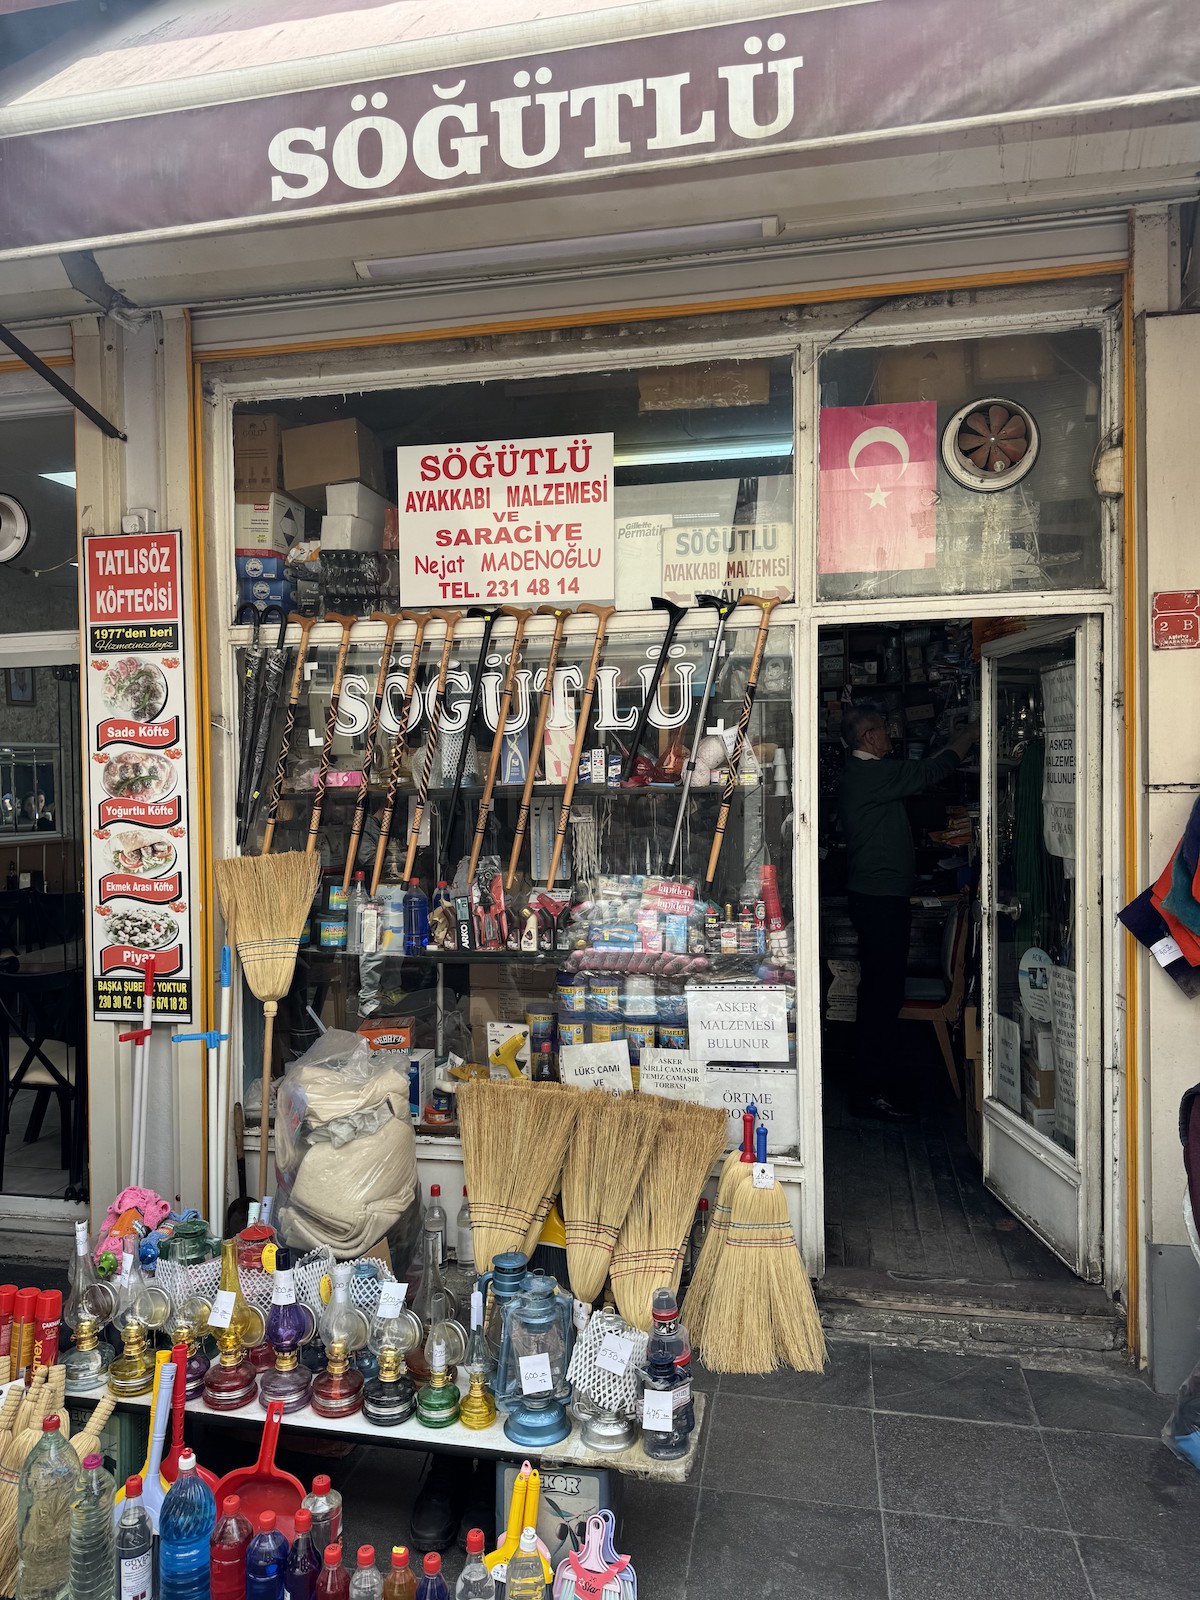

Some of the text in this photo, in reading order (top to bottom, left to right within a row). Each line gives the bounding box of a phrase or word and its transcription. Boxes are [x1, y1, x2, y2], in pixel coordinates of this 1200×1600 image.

[268, 33, 803, 201] SÖĞÜTLÜ
[420, 439, 592, 482] SÖĞÜTLÜ
[405, 475, 608, 513] AYAKKABI MALZEMESİ
[492, 511, 519, 523] VE
[626, 522, 652, 530] Gillette
[435, 522, 582, 547] SARACİYE
[676, 525, 777, 556] SÖĞÜTLÜ
[96, 542, 171, 576] TATLISÖZ
[415, 543, 601, 580] Nejat MADENOĞLU
[664, 556, 790, 582] AYAKKABI MALZEMESİ
[438, 576, 580, 599] TEL. 231 48 14
[96, 581, 173, 614] KÖFTECİSİ
[1159, 620, 1193, 631] 2 B
[94, 627, 173, 640] 1977'den beri
[107, 726, 170, 738] Sade Köfte
[1049, 739, 1073, 751] ASKER
[106, 805, 173, 818] Yoğurtlu Köfte
[106, 881, 174, 892] Ekmek Arası Köfte
[459, 923, 470, 949] ARKO
[97, 981, 122, 994] BAŞKA
[157, 982, 187, 993] YOKTUR
[99, 995, 112, 1008] 230
[112, 996, 122, 1009] 30
[123, 996, 132, 1009] 42
[156, 997, 168, 1010] 674
[169, 998, 178, 1010] 18
[179, 998, 188, 1010] 26
[715, 1002, 758, 1012] ASKER
[700, 1018, 775, 1031] MALZEMESİ
[707, 1038, 770, 1048] BULUNUR
[574, 1064, 620, 1076] LÜKS CAMI
[643, 1064, 698, 1074] KİRLİ ÇAMAŞIR
[593, 1078, 604, 1087] VE
[641, 1072, 700, 1083] TEMİZ ÇAMAŞIR
[723, 1089, 773, 1104] ÖRTME
[582, 1581, 600, 1594] Star
